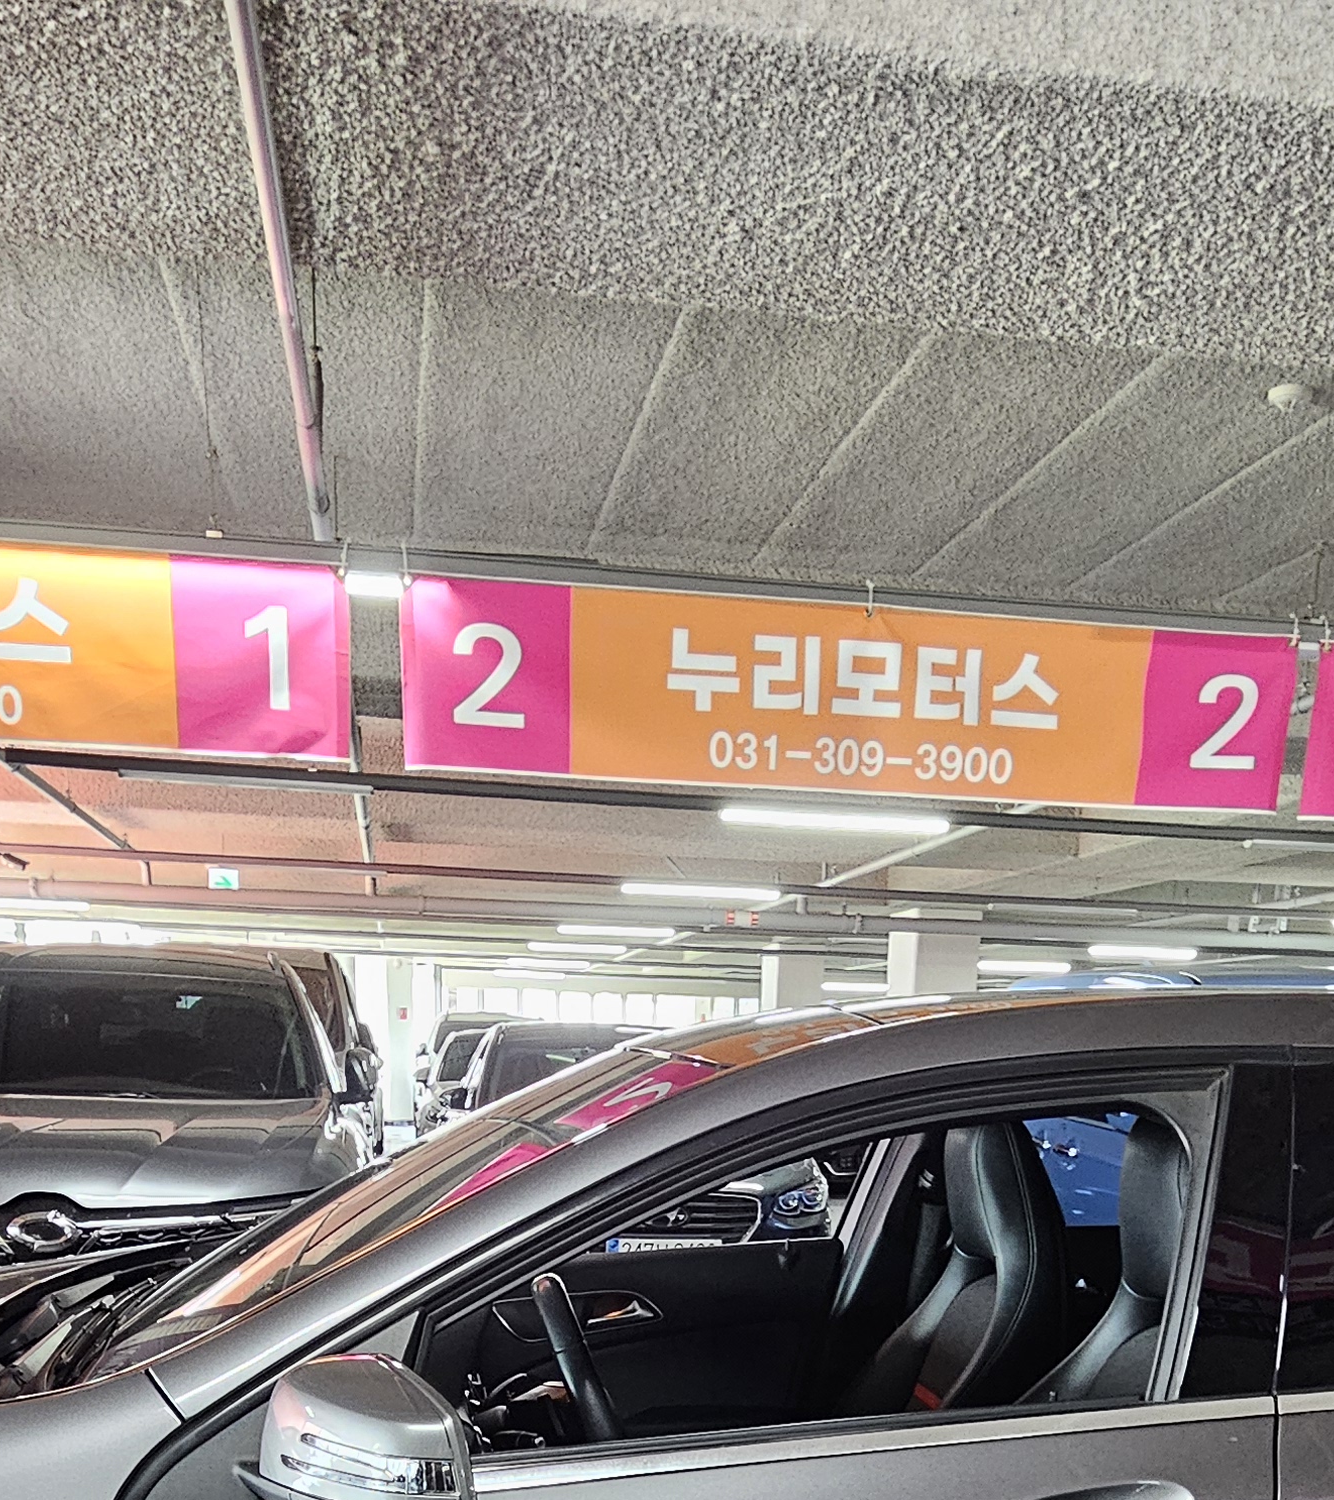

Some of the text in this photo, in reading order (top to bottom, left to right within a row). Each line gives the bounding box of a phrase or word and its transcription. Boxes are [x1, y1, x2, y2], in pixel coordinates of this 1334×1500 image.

[243, 604, 292, 712] 1
[452, 622, 526, 729] 2
[666, 627, 1060, 731] 누리모터스
[708, 729, 1013, 786] 031-309-3900
[1189, 673, 1259, 771] 2
